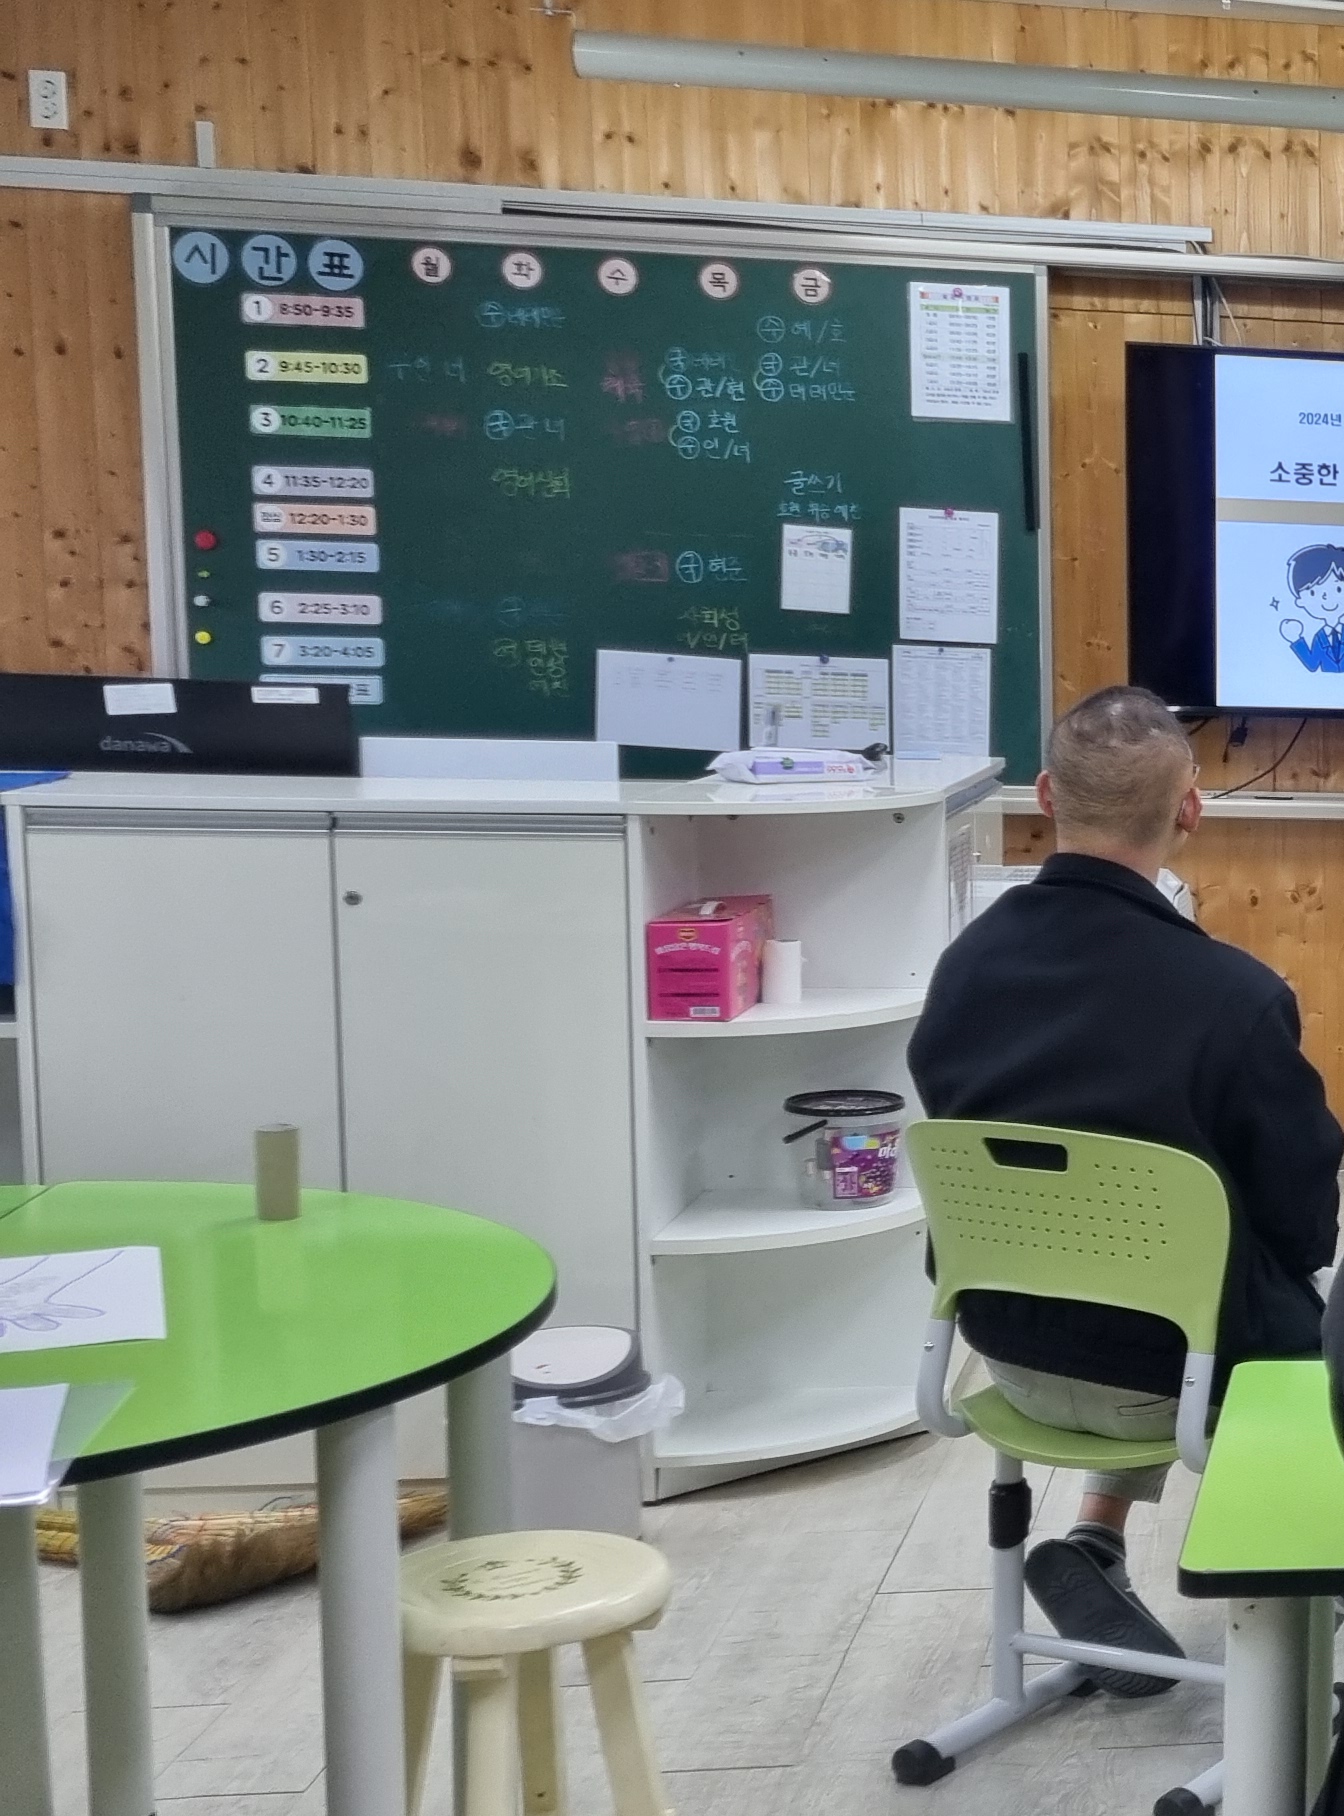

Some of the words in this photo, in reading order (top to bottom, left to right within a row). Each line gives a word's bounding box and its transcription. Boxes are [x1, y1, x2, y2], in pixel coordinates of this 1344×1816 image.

[420, 256, 439, 278] 월
[515, 260, 534, 280] 화
[607, 265, 629, 284] 수
[708, 270, 729, 293] 목
[800, 276, 821, 298] 금
[252, 301, 262, 316] 1
[279, 303, 354, 319] 8:50-9:35
[256, 359, 270, 374] 2
[279, 359, 362, 377] 9:45-10:30
[258, 413, 273, 428] 3
[281, 414, 367, 431] 10:40-11:25
[1298, 411, 1342, 428] 2024년
[260, 474, 275, 489] 4
[284, 474, 369, 490] 11:35-12:20
[1269, 461, 1340, 488] 소중한
[288, 512, 368, 527] 12:20-1:30
[267, 547, 280, 562] 5
[297, 550, 366, 564] 1:30-2:15
[270, 600, 283, 615] 6
[298, 602, 370, 616] 2:25-3:10
[271, 643, 286, 658] 7
[299, 645, 375, 658] 3:20-4:05
[100, 735, 172, 753] danawa
